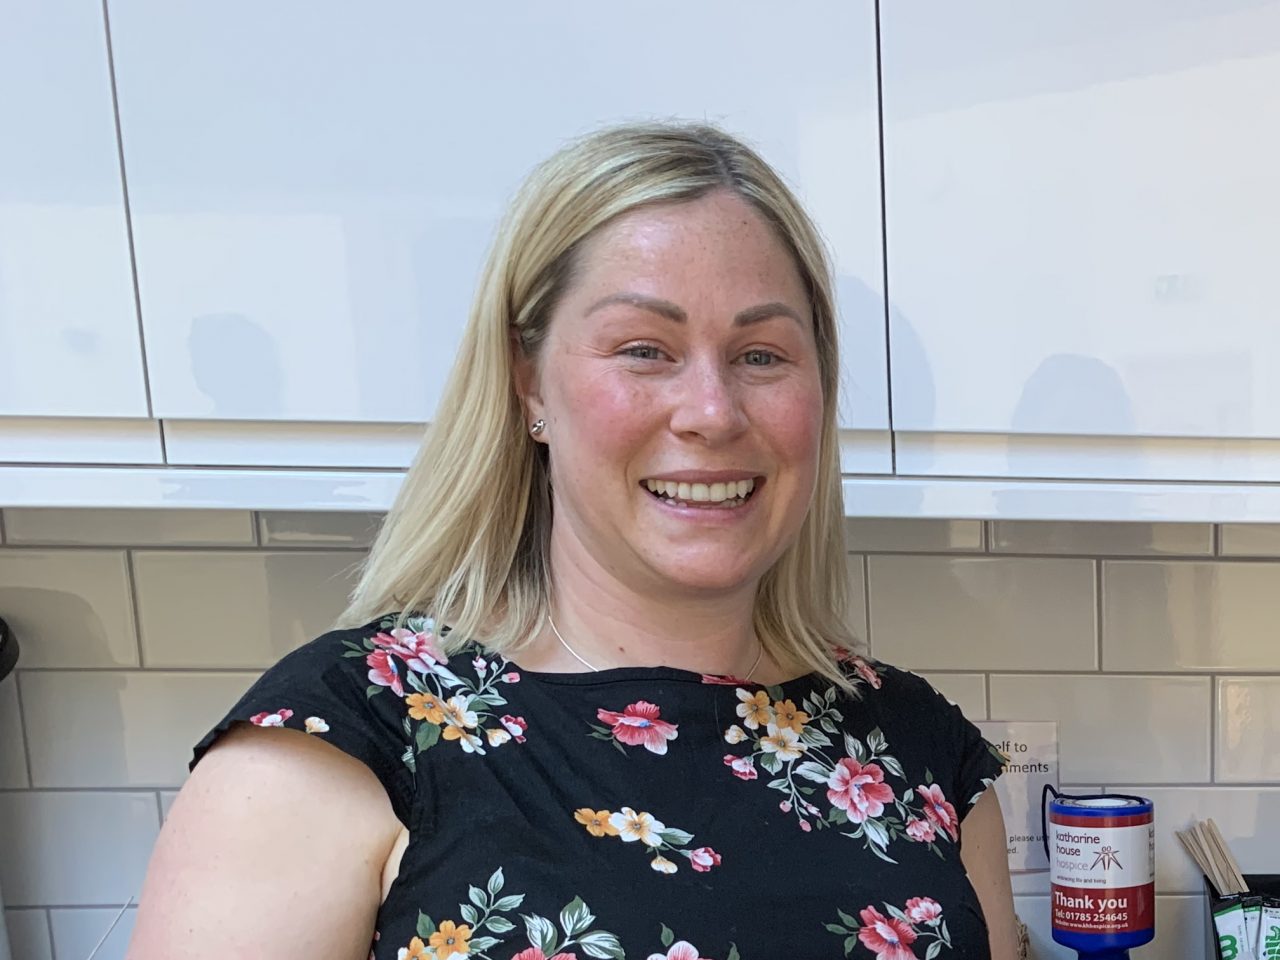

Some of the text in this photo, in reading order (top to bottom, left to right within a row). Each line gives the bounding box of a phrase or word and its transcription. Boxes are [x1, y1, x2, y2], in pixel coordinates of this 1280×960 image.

[1015, 742, 1027, 752] to
[1010, 834, 1035, 843] please
[1056, 830, 1100, 844] katharine
[1056, 843, 1080, 856] house
[1056, 858, 1088, 871] hospice
[1055, 891, 1128, 912] Thank you
[1055, 909, 1128, 921] Tel: 01785 254645
